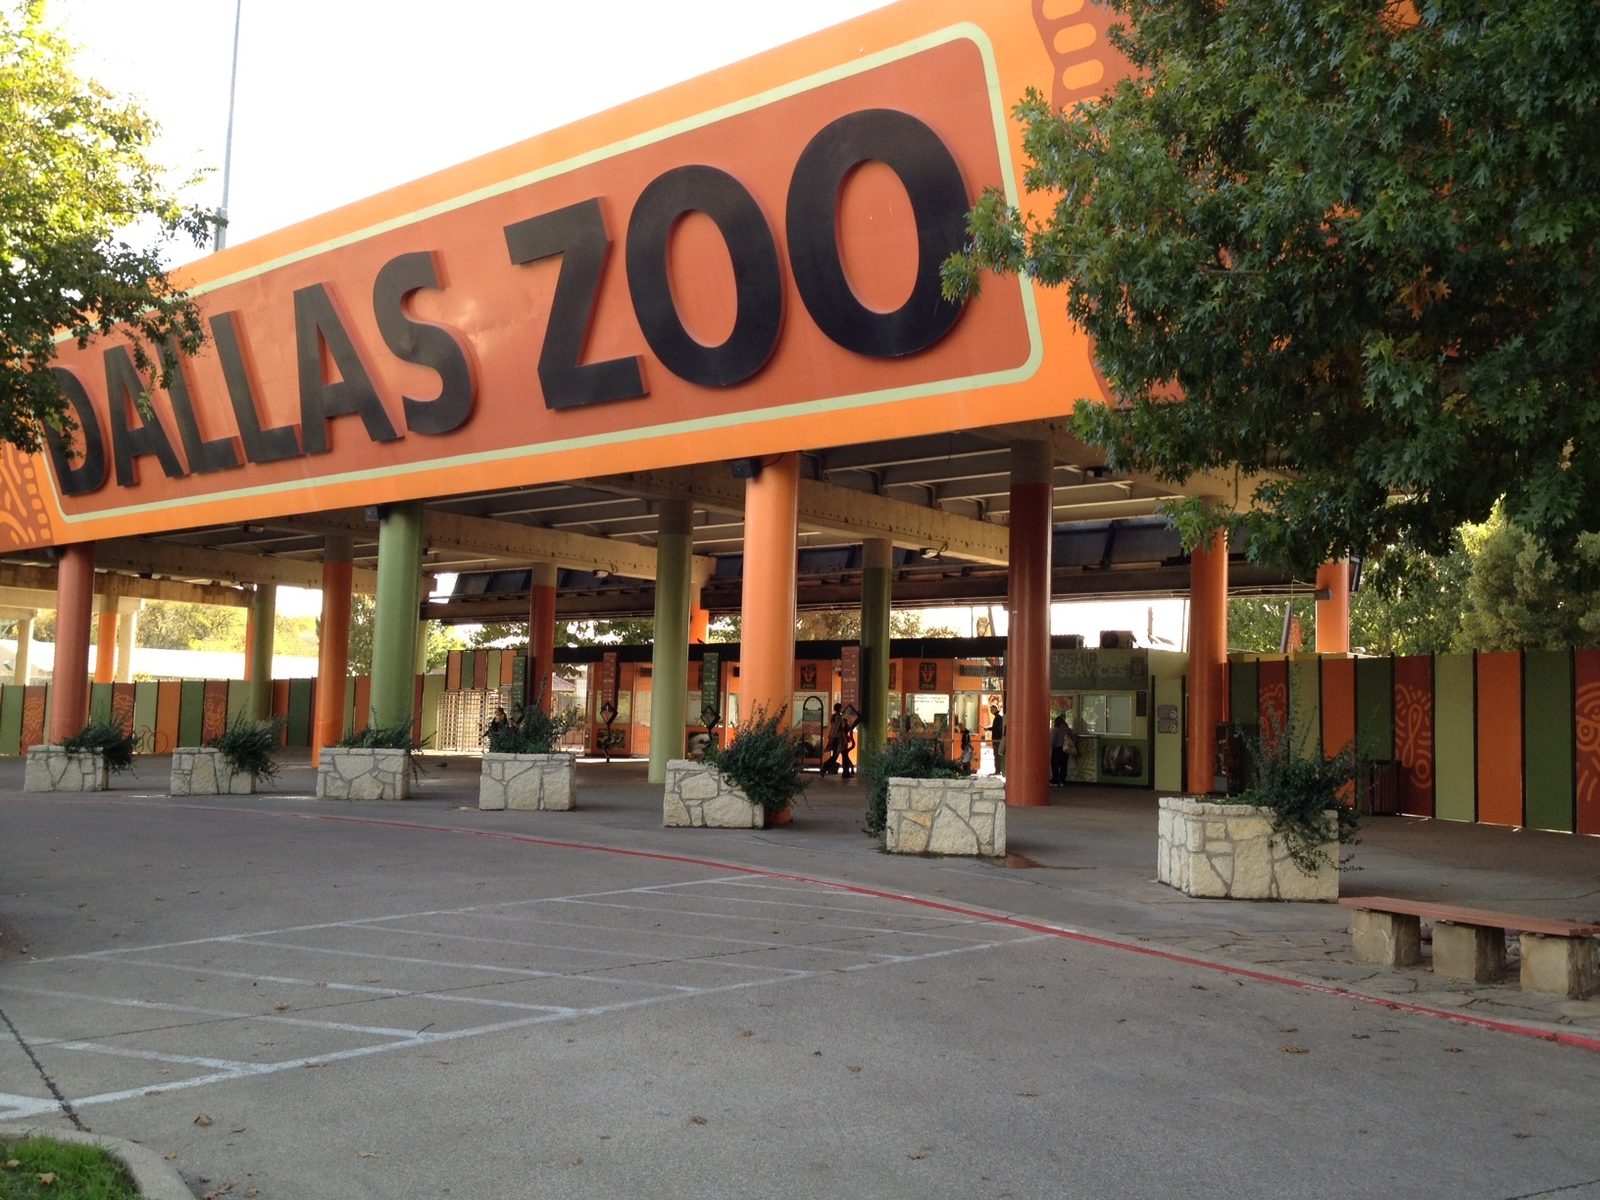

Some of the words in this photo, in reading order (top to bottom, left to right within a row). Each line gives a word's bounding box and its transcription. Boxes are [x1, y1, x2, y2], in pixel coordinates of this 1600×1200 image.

[42, 249, 477, 496] DALLAS
[503, 108, 972, 410] ZOO
[1051, 653, 1098, 666] RSHIP
